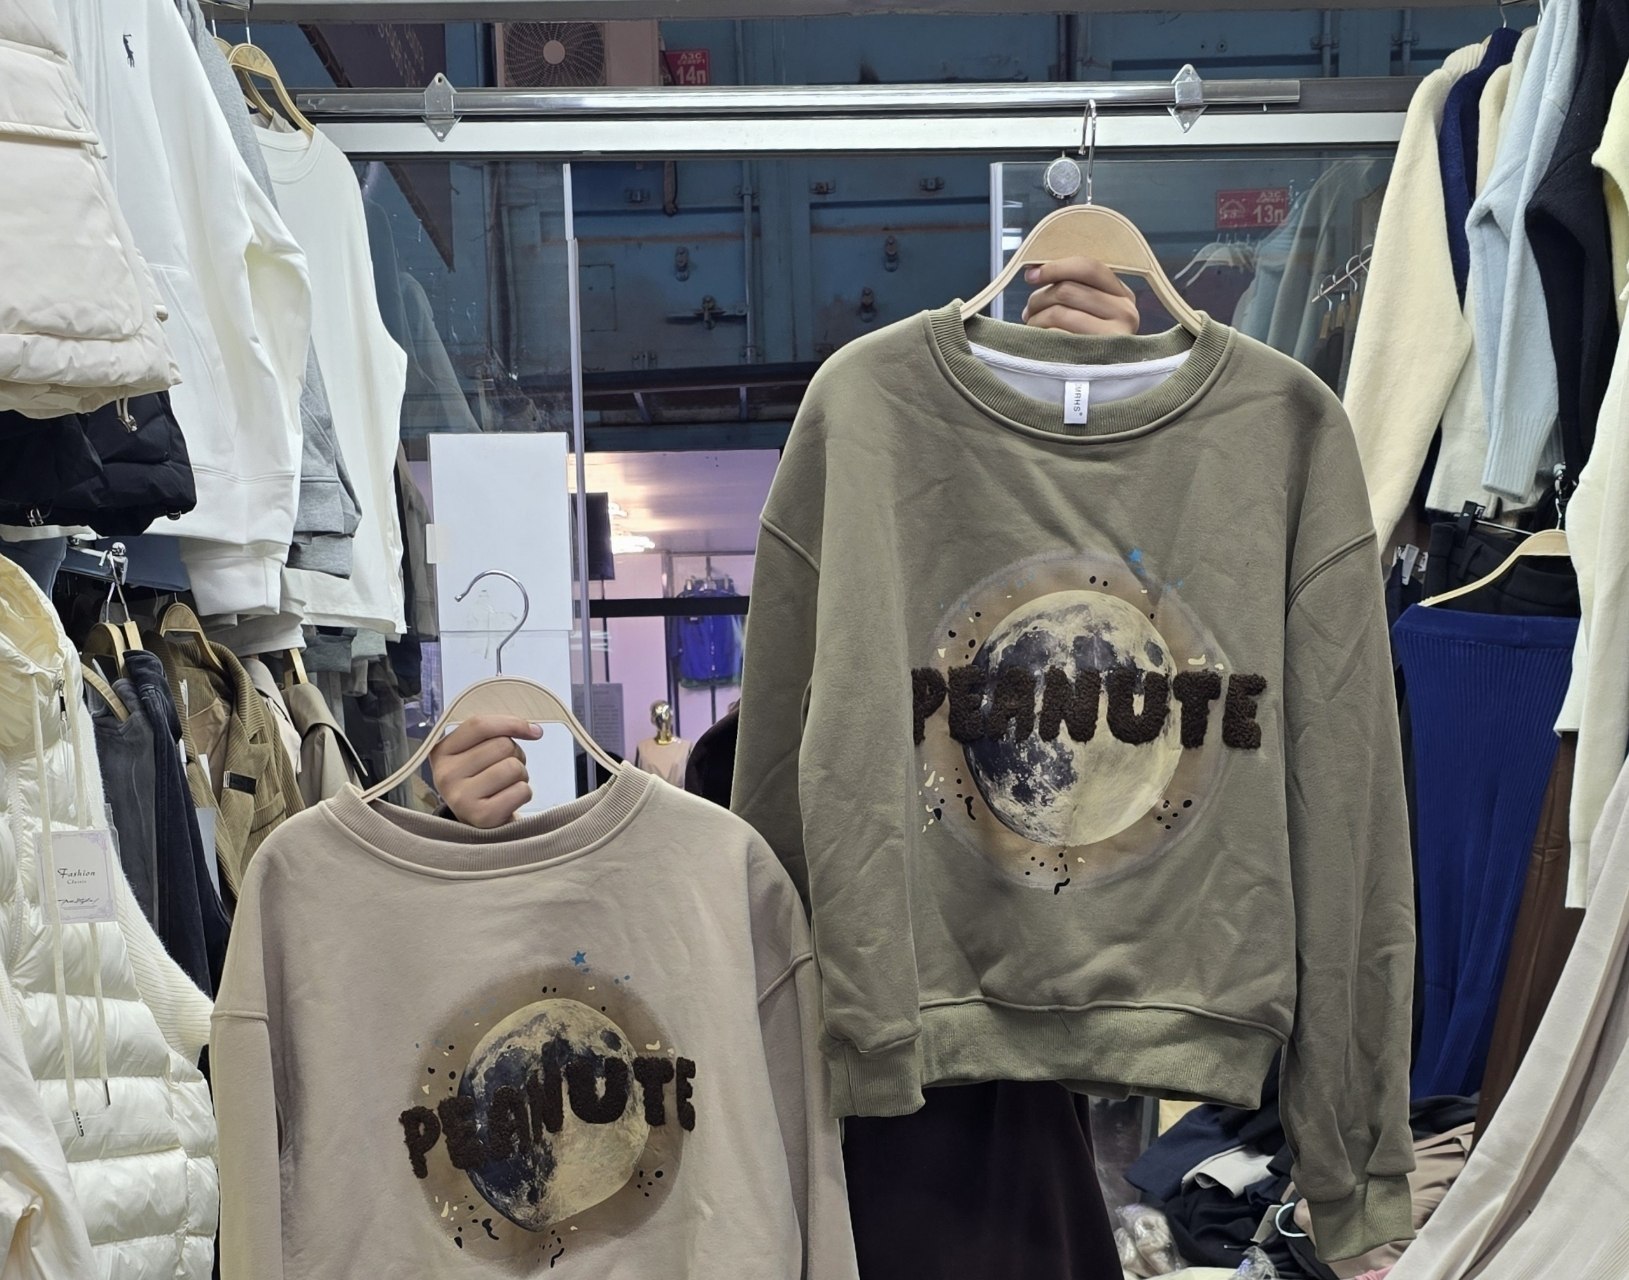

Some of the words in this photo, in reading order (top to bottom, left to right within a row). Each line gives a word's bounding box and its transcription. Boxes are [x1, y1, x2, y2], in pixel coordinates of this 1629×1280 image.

[910, 663, 1268, 750] PEANUTE
[57, 867, 96, 879] Fashion
[398, 1039, 697, 1180] PEANUTE
